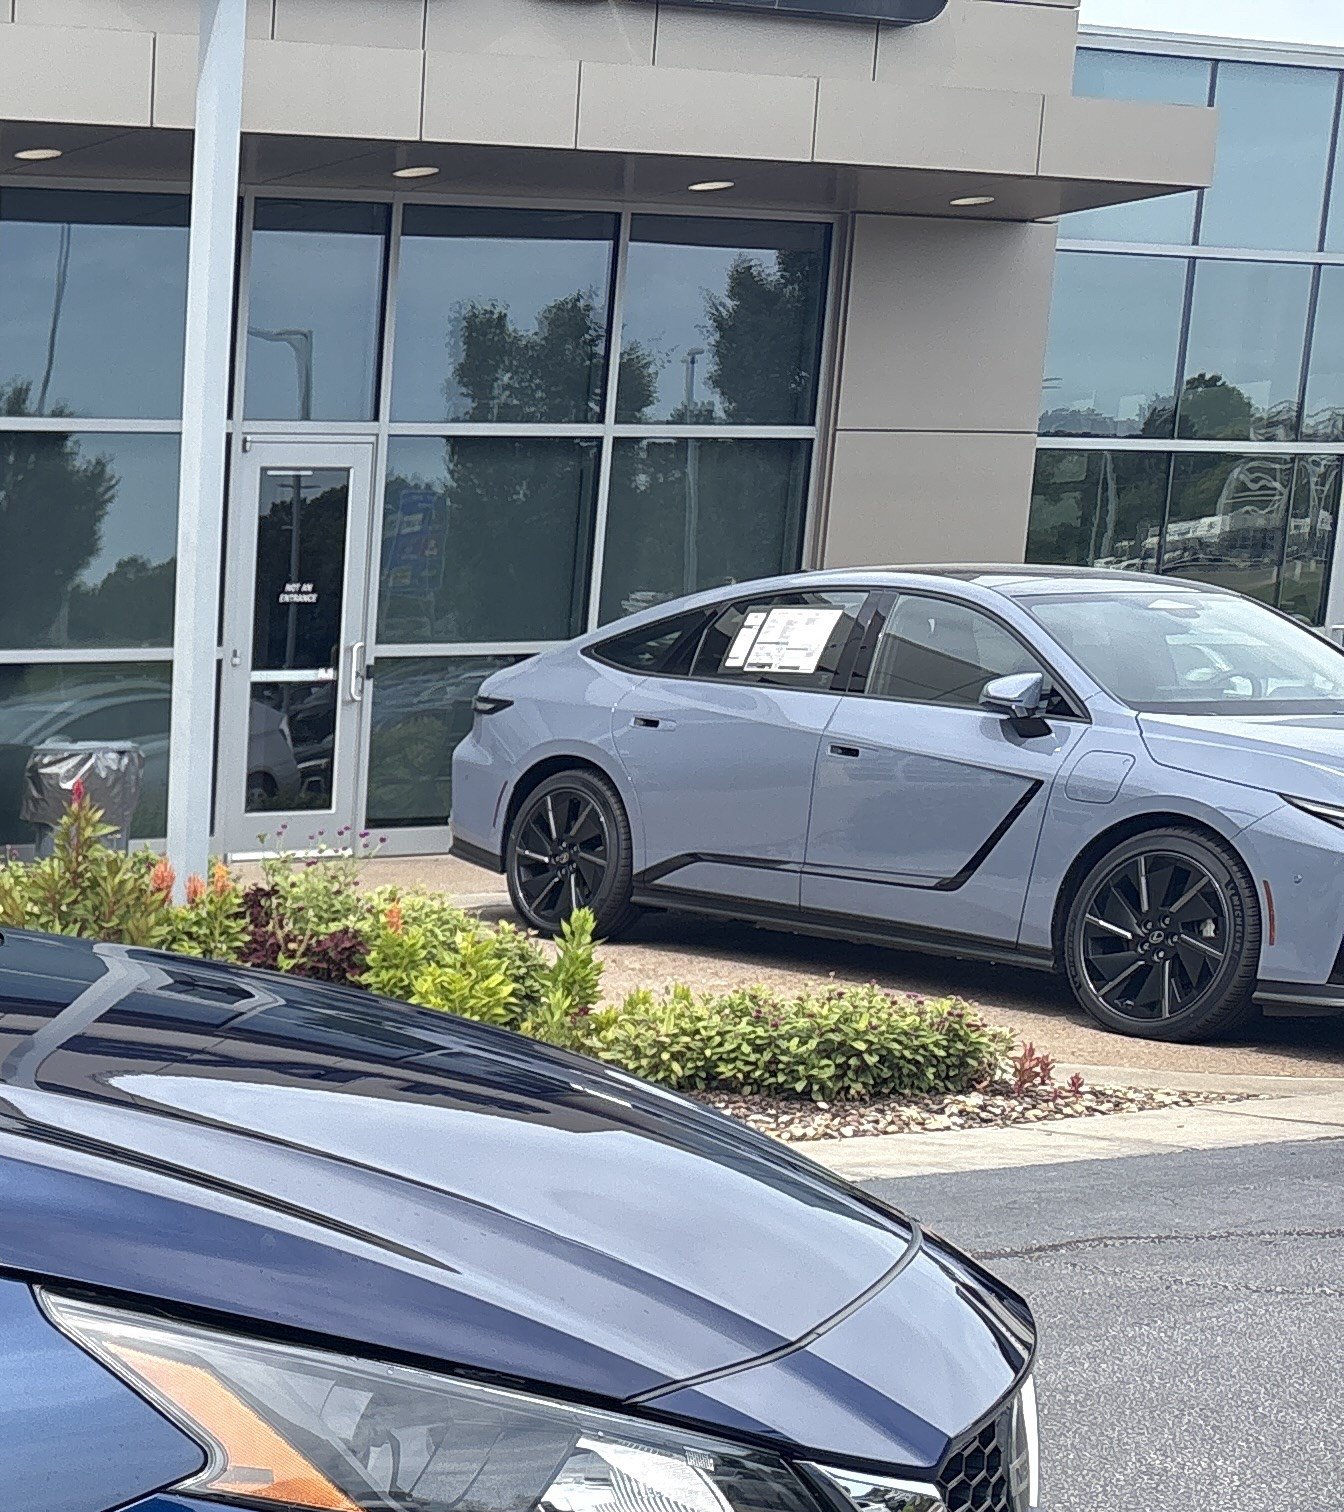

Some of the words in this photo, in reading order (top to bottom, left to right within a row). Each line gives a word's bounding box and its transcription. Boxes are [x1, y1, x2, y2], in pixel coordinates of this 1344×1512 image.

[284, 582, 301, 592] NOT
[301, 582, 314, 592] AN
[278, 592, 318, 603] ENTRANCE
